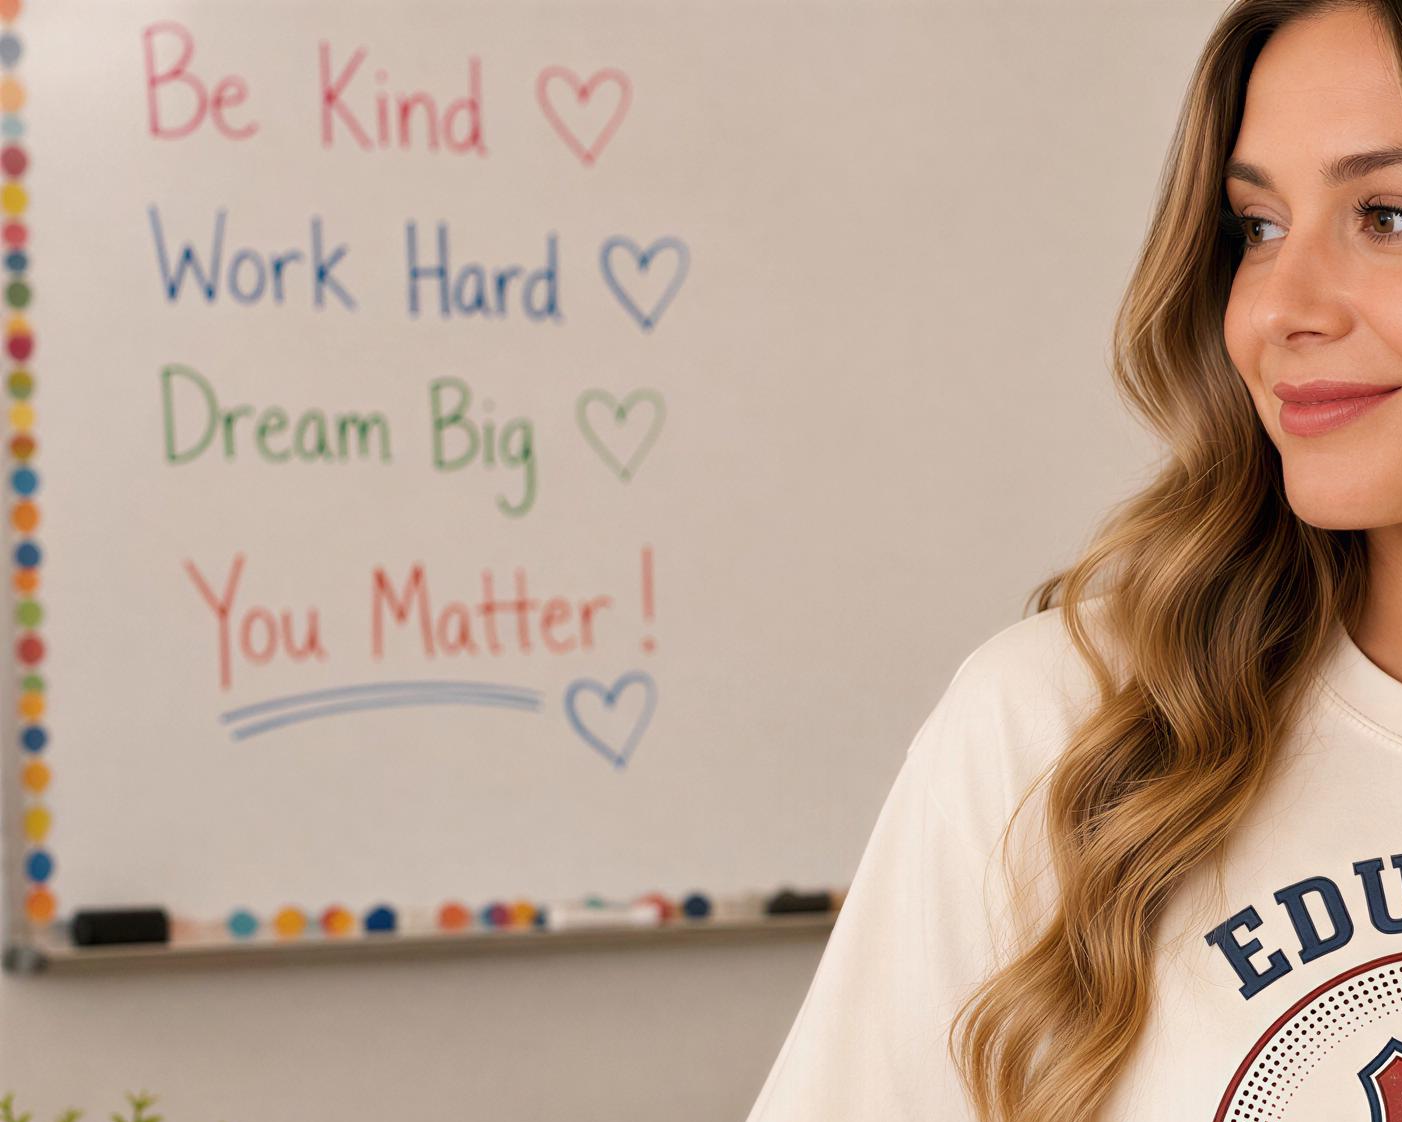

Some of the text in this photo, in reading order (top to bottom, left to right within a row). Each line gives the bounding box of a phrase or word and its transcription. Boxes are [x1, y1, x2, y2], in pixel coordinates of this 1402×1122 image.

[143, 22, 488, 157] Be Kind
[148, 204, 565, 325] Work Hard
[160, 363, 538, 519] Dream Big
[184, 551, 328, 692] You
